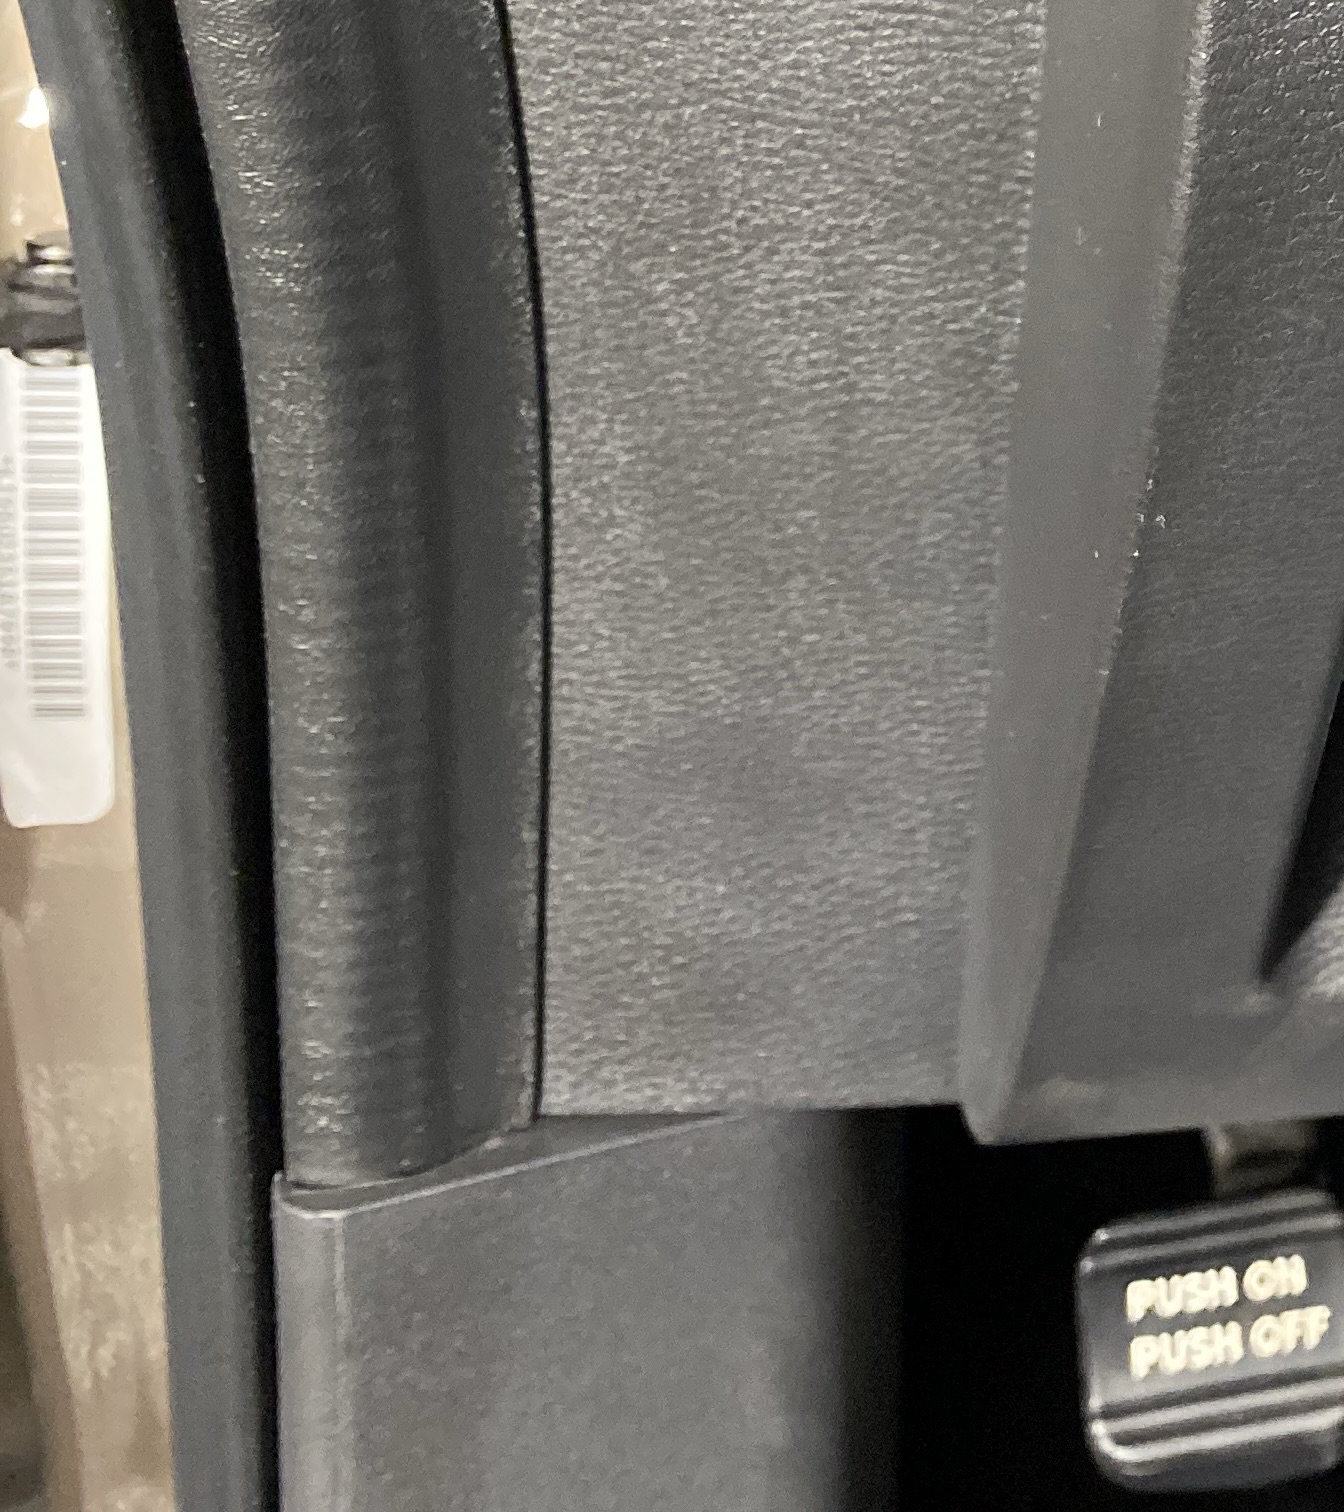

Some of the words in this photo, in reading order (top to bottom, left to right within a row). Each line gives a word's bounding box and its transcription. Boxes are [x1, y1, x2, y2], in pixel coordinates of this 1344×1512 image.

[1126, 1265, 1239, 1324] PUSH
[1243, 1254, 1310, 1303] ON
[1129, 1320, 1245, 1382] PUSH
[1250, 1304, 1332, 1359] OFF
